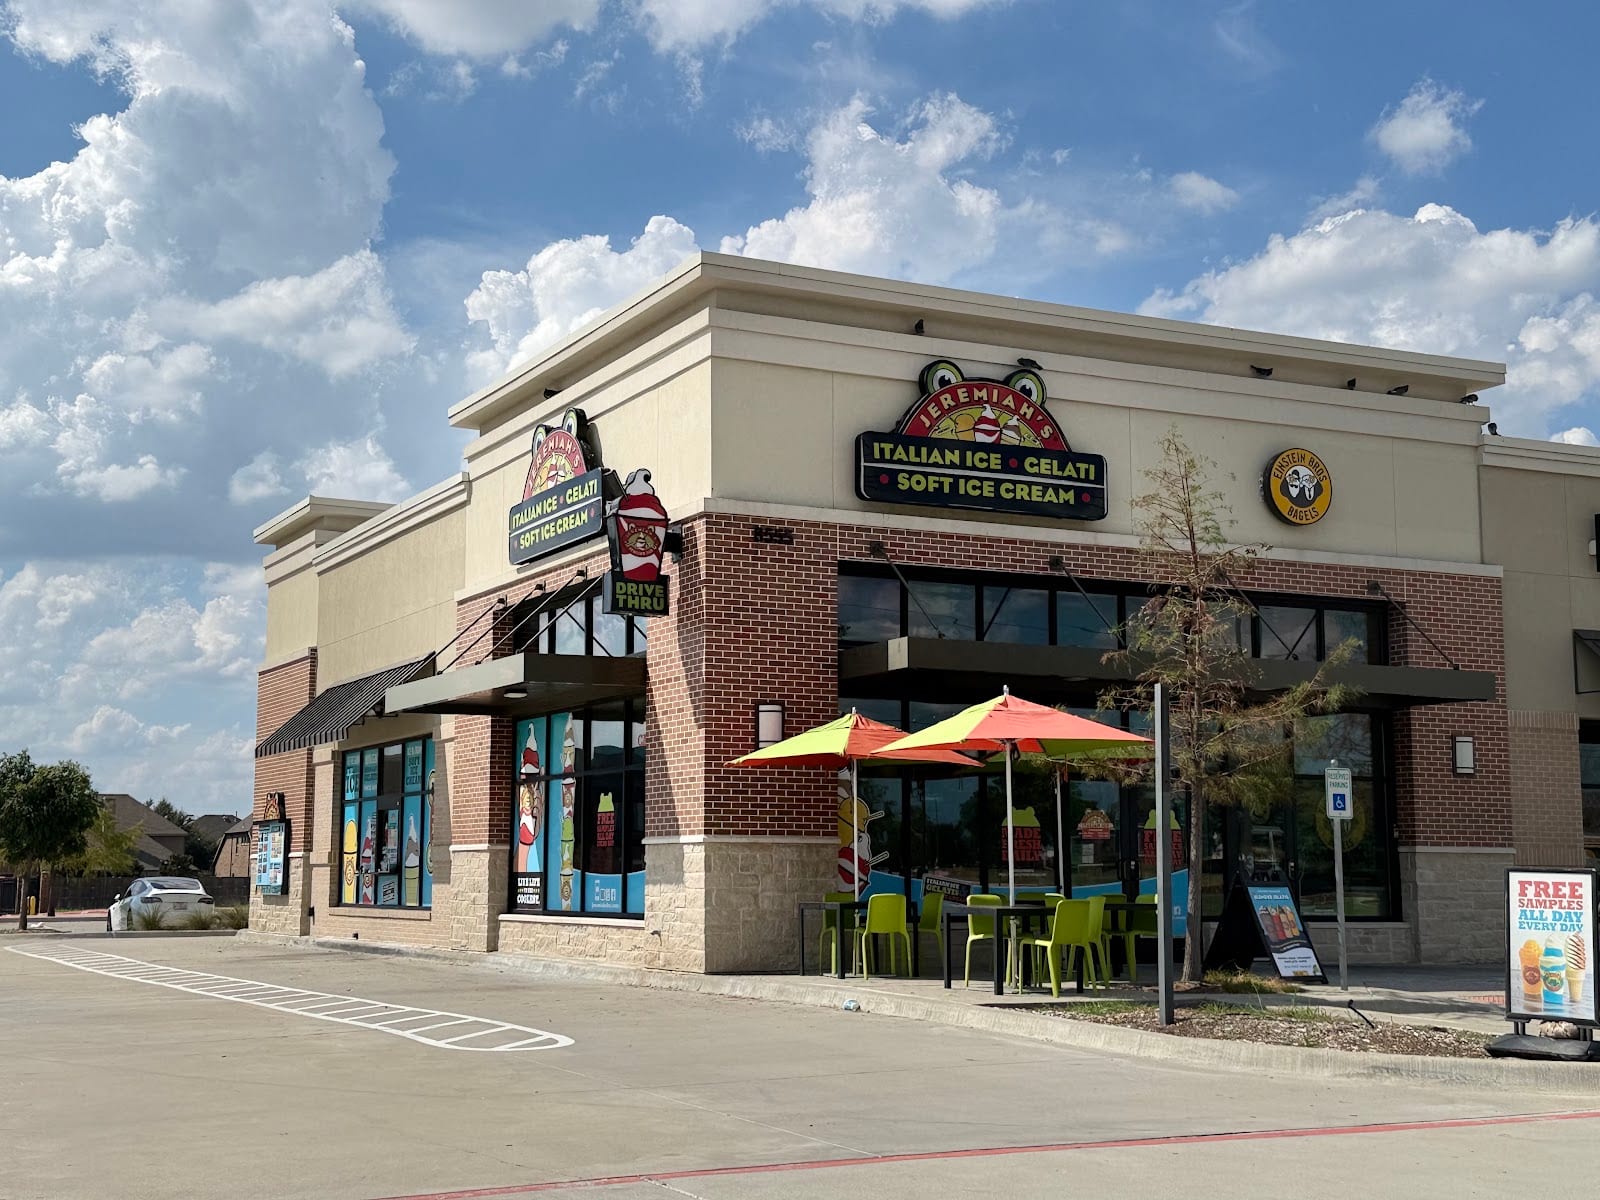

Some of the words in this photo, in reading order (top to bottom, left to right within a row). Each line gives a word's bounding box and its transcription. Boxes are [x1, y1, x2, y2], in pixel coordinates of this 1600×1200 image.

[921, 387, 1053, 440] JEREMIAH'S
[873, 442, 960, 466] ITALIAN
[966, 451, 1002, 470] ICE
[1024, 456, 1096, 480] GELATI
[1273, 451, 1306, 480] EINSTEIN
[1308, 456, 1328, 482] BROS
[897, 473, 953, 494] SOFT
[958, 479, 995, 498] ICE
[1000, 484, 1075, 505] CREAM
[512, 501, 542, 529] ITALIAN
[543, 495, 558, 514] ICE
[565, 479, 598, 504] GELATI
[1287, 506, 1319, 521] BAGELS
[519, 528, 540, 549] SOFT
[541, 521, 556, 540] ICE
[556, 508, 588, 534] CREAM
[615, 581, 664, 598] DRIVE
[615, 594, 665, 611] THRU
[1517, 880, 1583, 900] FREE
[1517, 898, 1584, 910] SAMPLES
[1518, 909, 1548, 921] ALL
[1551, 911, 1584, 923] DAY
[1518, 921, 1557, 932] EVERY
[1559, 922, 1584, 933] DAY
